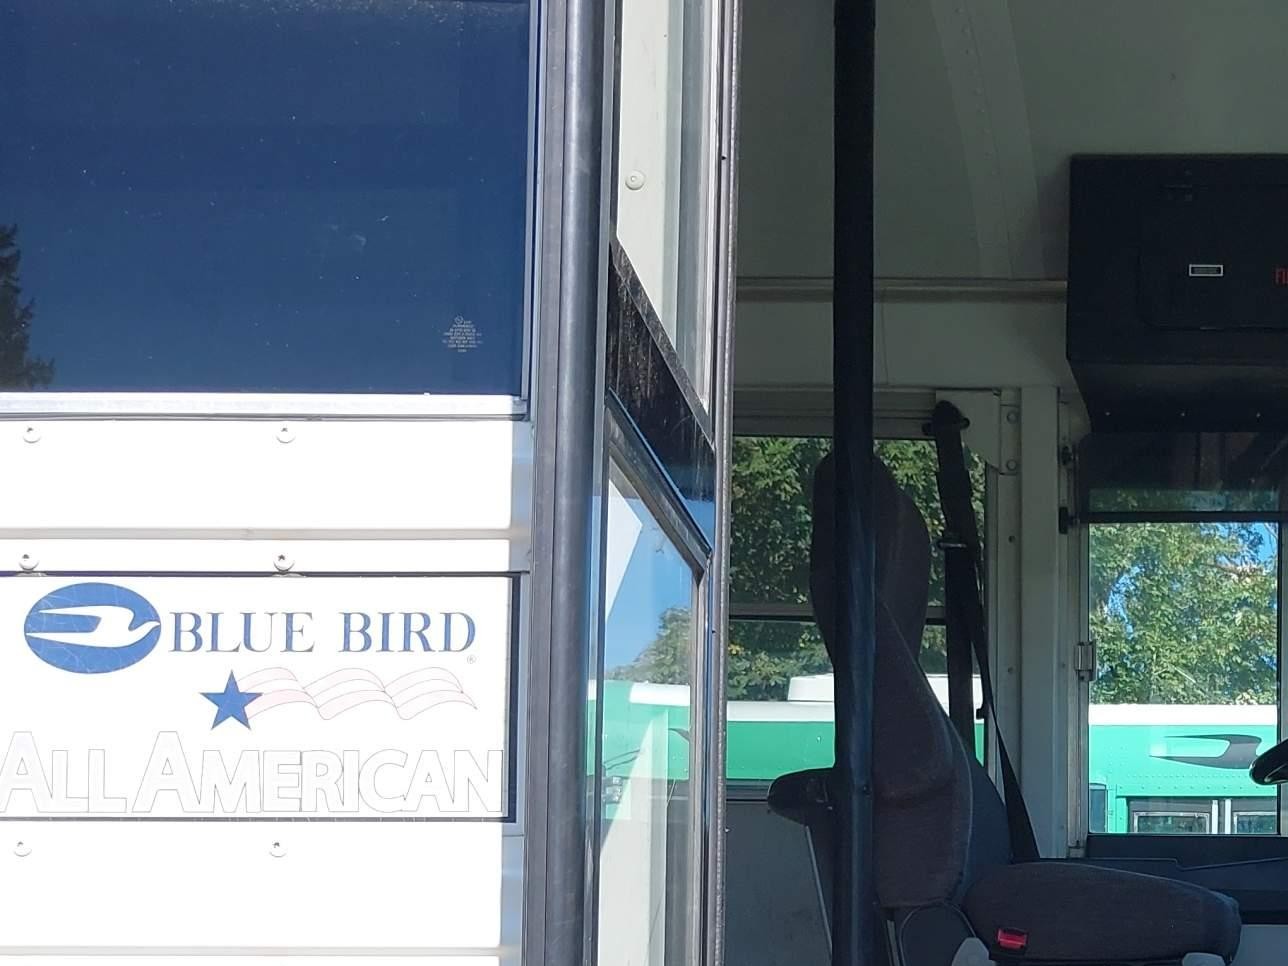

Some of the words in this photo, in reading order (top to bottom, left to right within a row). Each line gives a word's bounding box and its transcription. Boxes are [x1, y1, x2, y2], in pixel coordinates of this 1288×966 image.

[168, 611, 314, 653] BLUE
[338, 611, 476, 653] BIRD
[1, 731, 127, 813] ALL
[131, 731, 504, 813] AMERICAN
